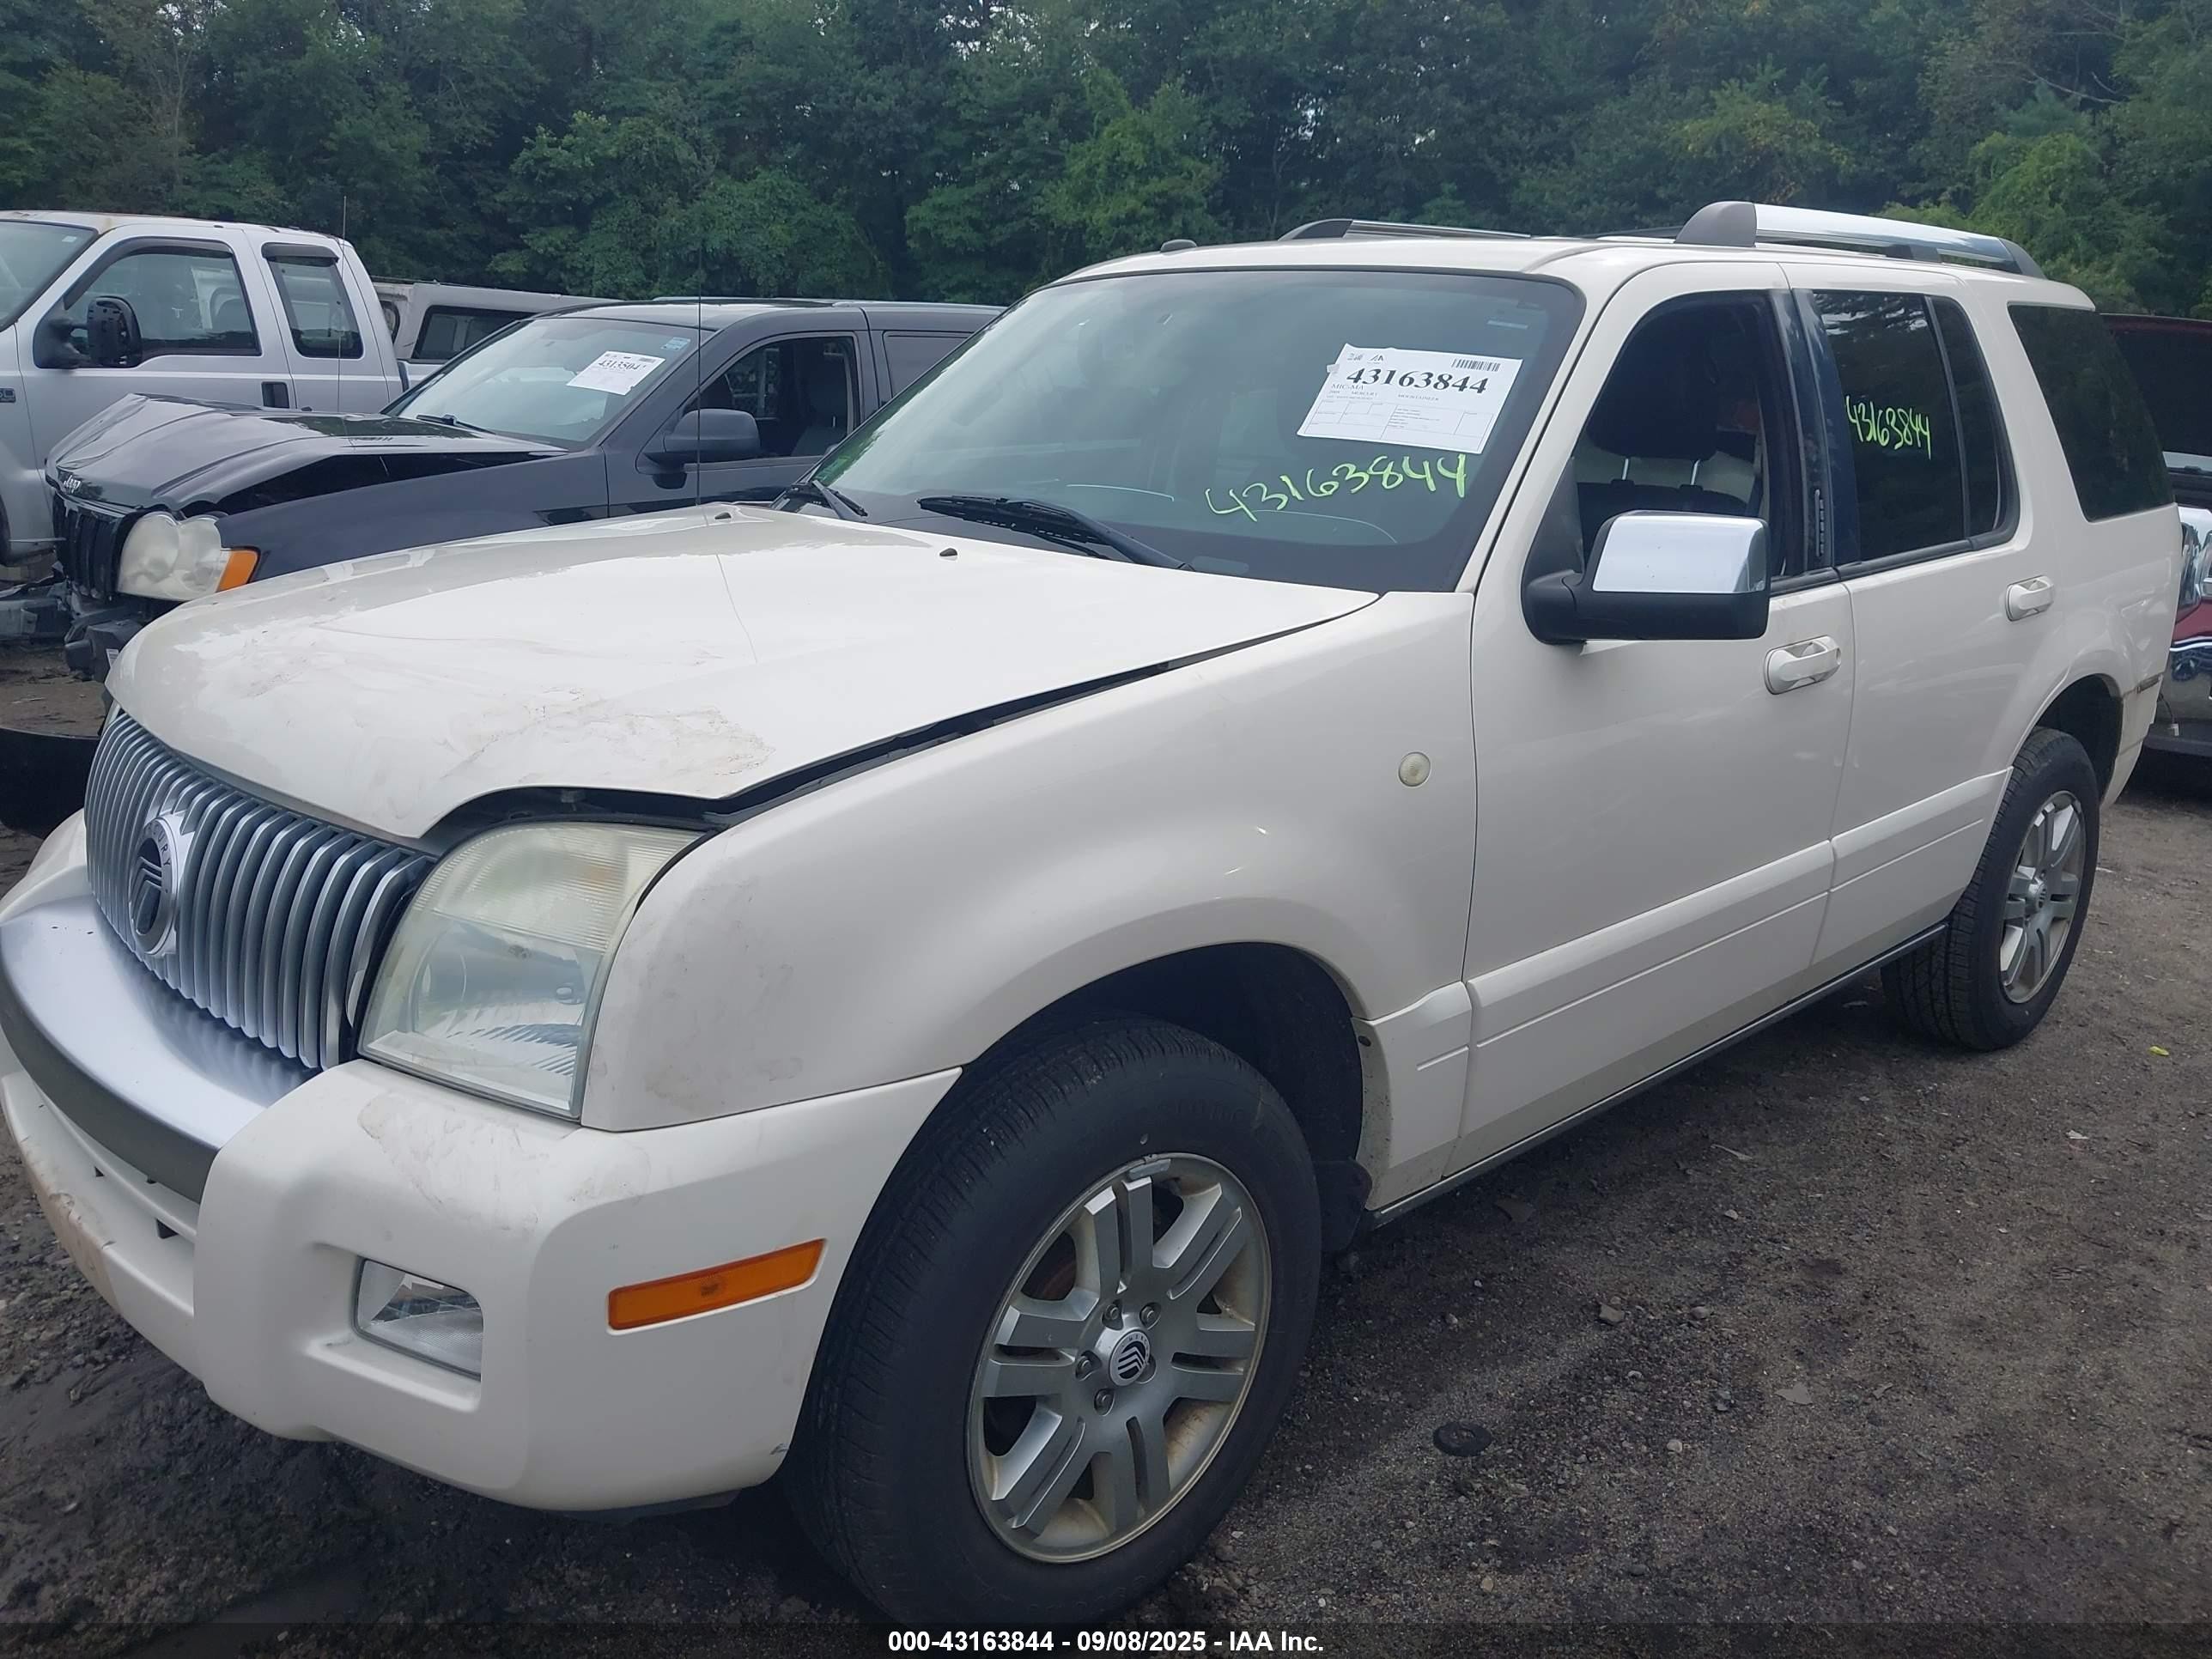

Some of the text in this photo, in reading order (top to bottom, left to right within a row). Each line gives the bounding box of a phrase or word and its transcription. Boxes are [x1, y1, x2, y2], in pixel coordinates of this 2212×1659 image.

[1346, 368, 1489, 394] 43163844
[1845, 395, 1931, 460] 43163844
[63, 475, 82, 494] Jeep
[1205, 453, 1467, 522] 43163844
